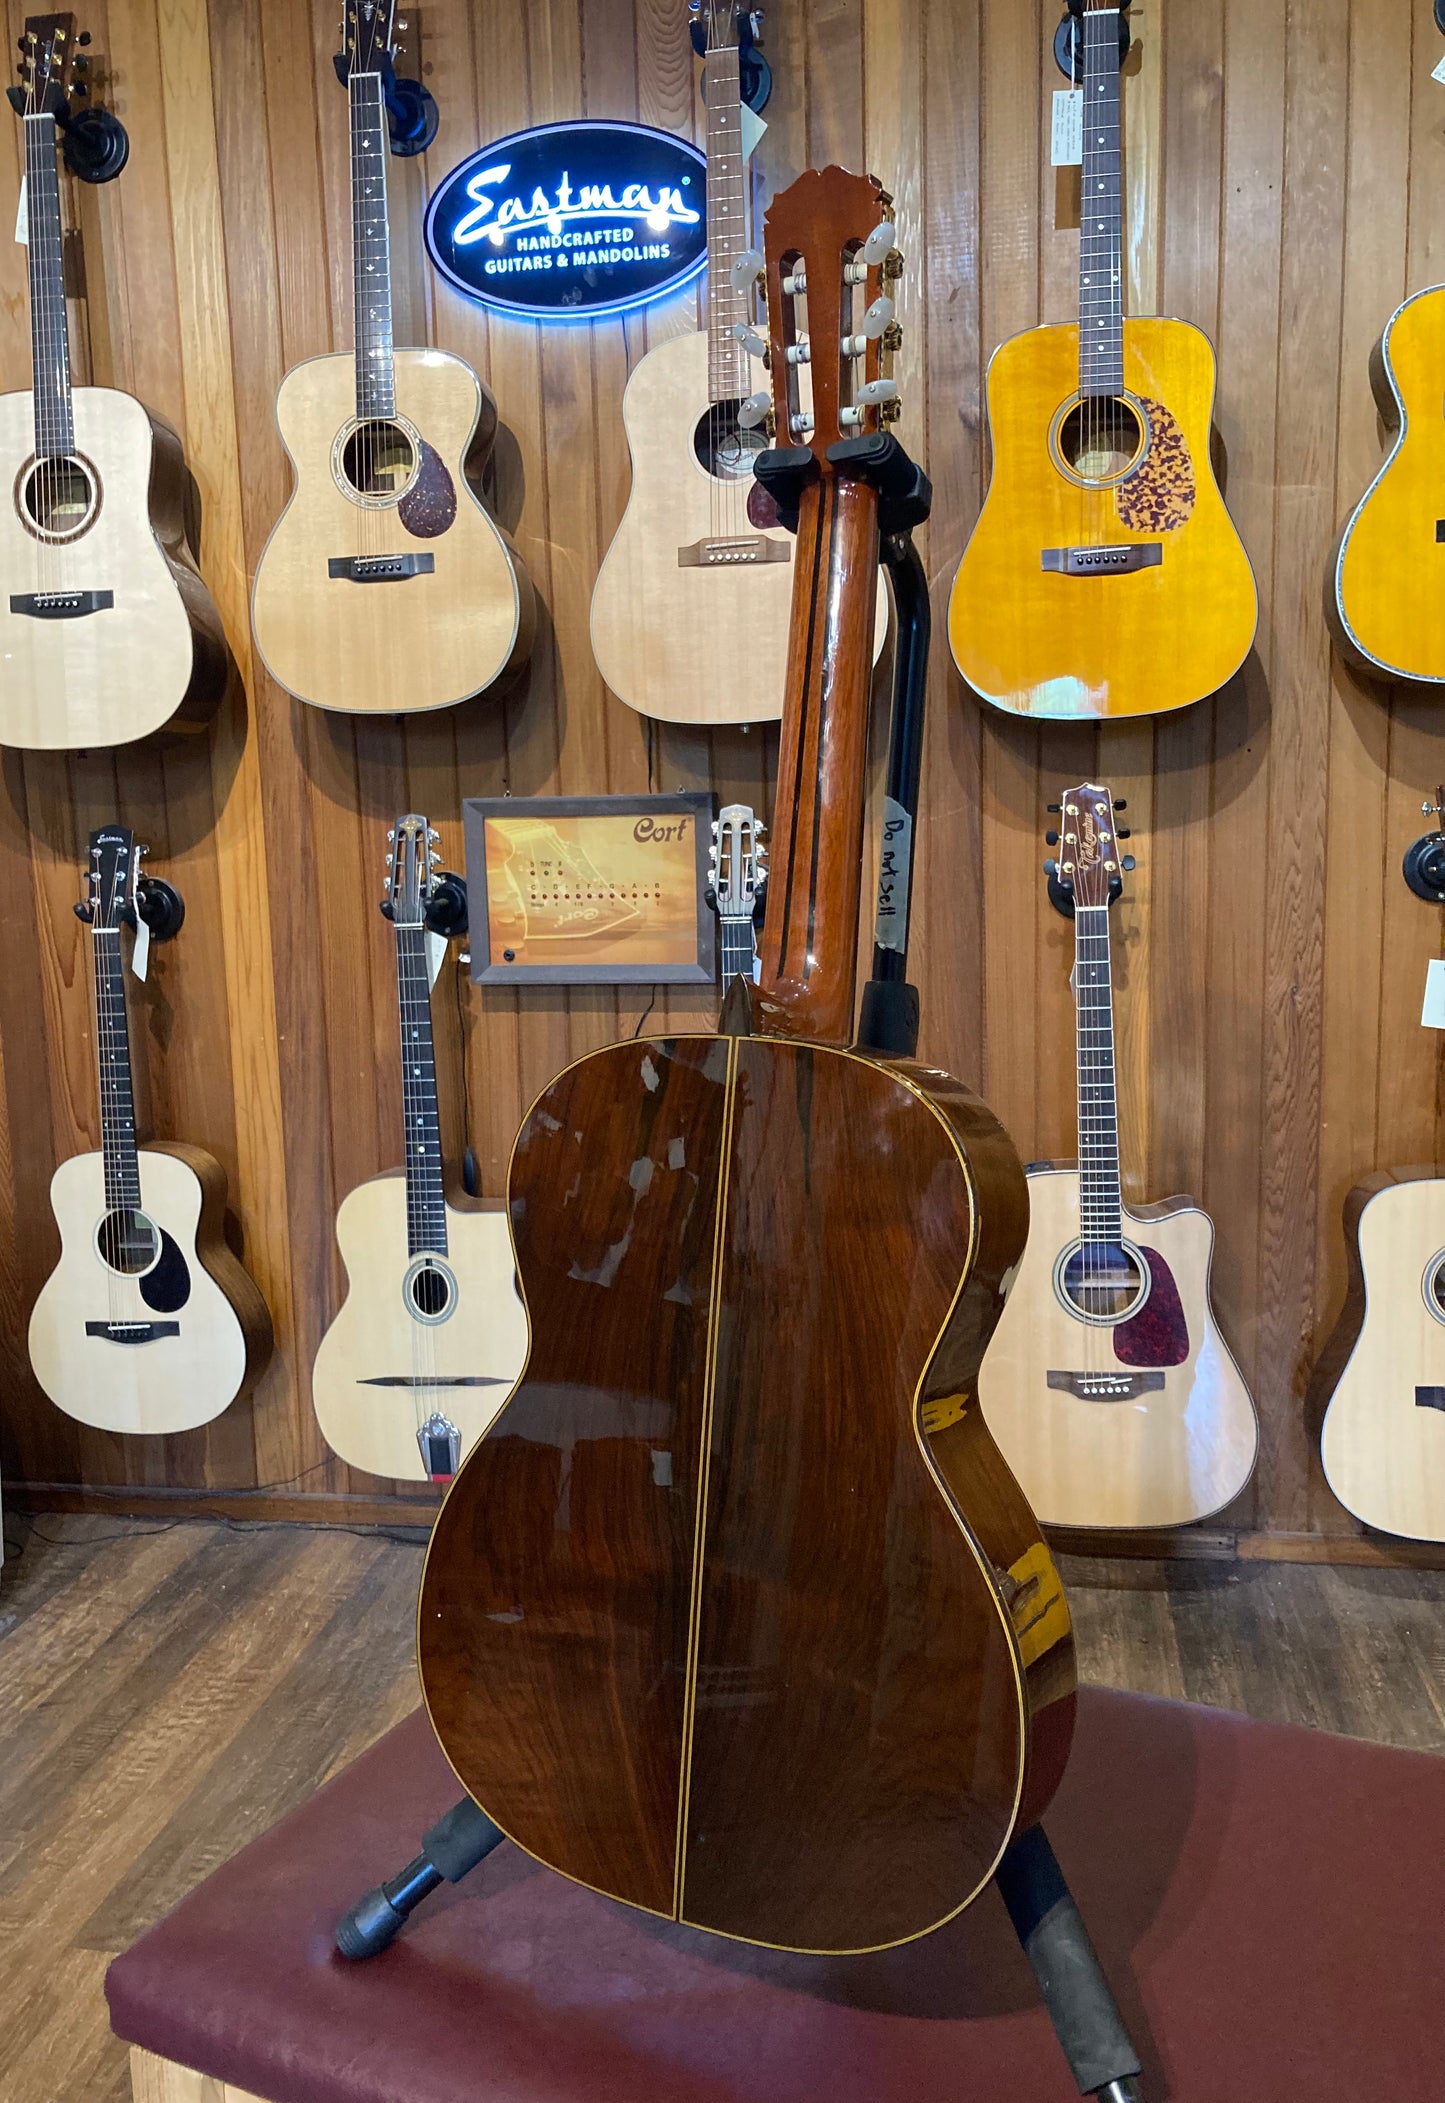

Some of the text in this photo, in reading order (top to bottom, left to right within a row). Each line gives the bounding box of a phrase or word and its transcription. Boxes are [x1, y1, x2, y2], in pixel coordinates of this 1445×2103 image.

[454, 165, 700, 245] Eastman
[517, 228, 634, 251] HANDCRAFTED
[485, 244, 670, 274] GUITARS & MANDOLINS
[633, 817, 687, 843] Cort
[884, 819, 904, 841] Do
[882, 851, 899, 876] not
